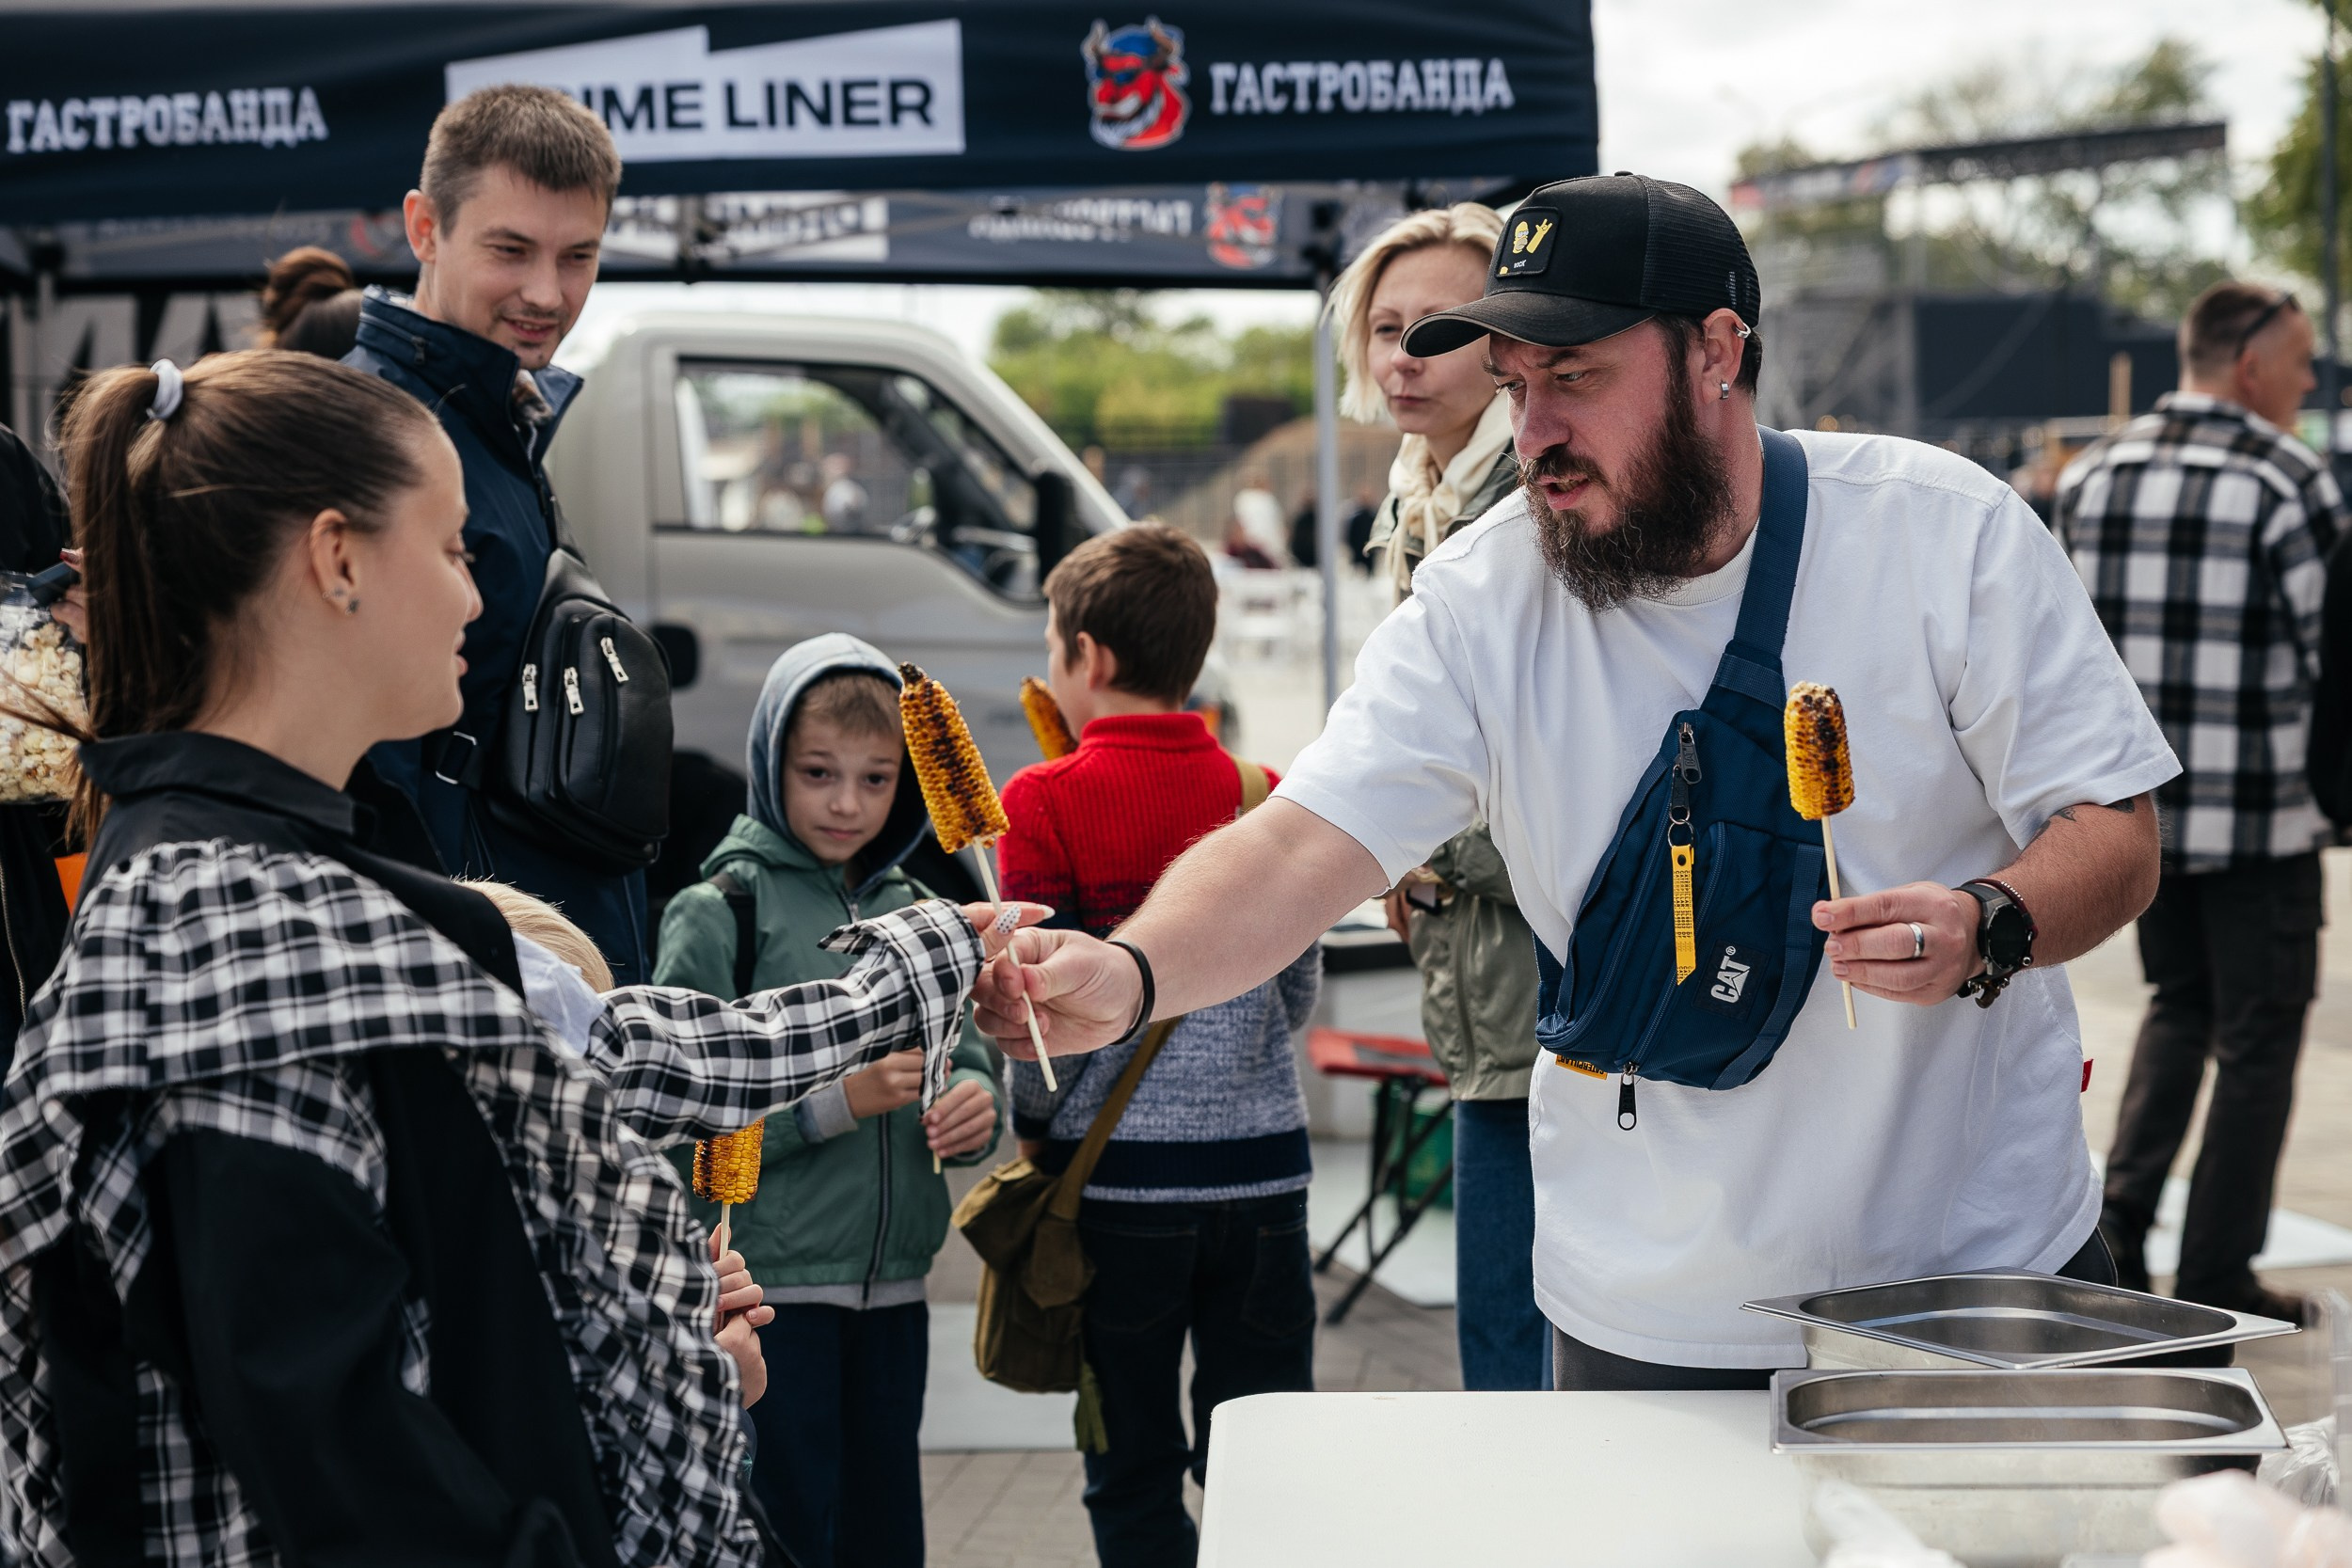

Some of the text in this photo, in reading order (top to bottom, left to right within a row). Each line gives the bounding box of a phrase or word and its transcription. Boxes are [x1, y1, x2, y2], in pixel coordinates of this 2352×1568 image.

[725, 78, 932, 129] LINER
[1209, 57, 1515, 115] ГАСТРОБАНДА
[6, 87, 327, 153] ГАСТРОБАНДА
